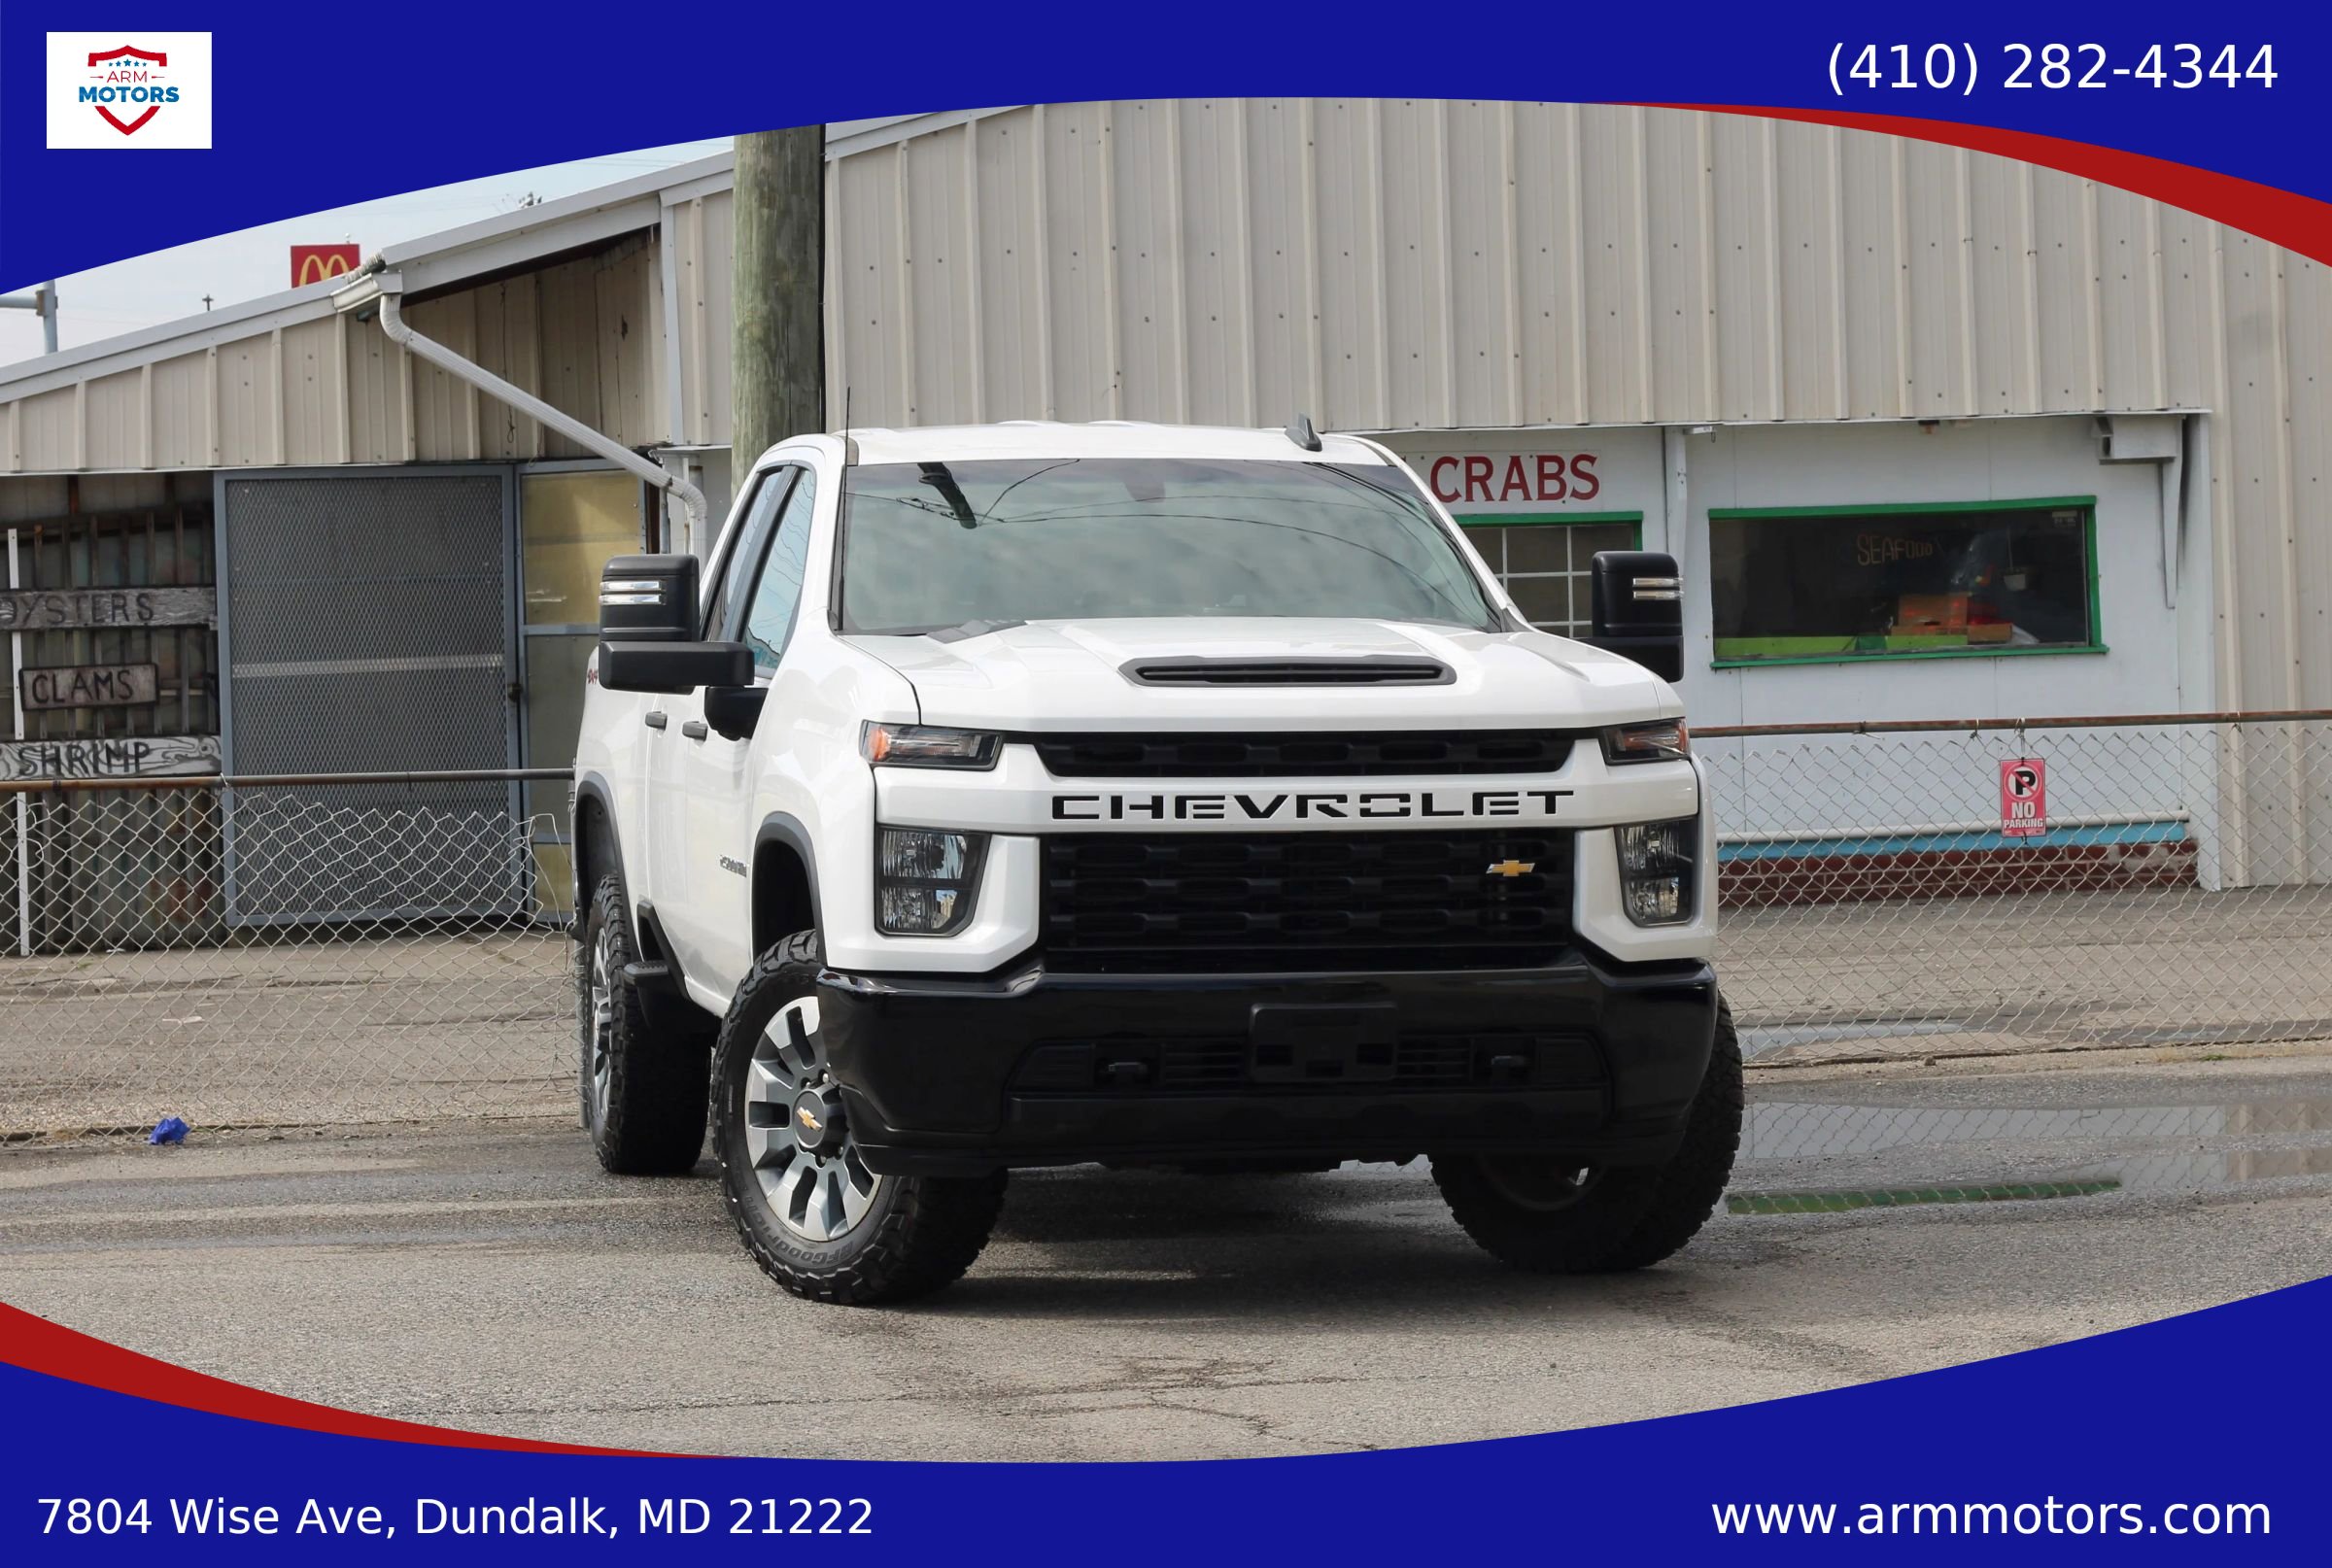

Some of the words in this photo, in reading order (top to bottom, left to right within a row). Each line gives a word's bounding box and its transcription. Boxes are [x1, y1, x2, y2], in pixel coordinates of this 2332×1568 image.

[1429, 453, 1600, 503] CRABS
[32, 669, 134, 704] CLAMS
[18, 741, 151, 776] SHRIMP
[1051, 790, 1574, 820] CHEVROLET
[2011, 801, 2036, 819] NO
[2004, 818, 2044, 829] PARKING
